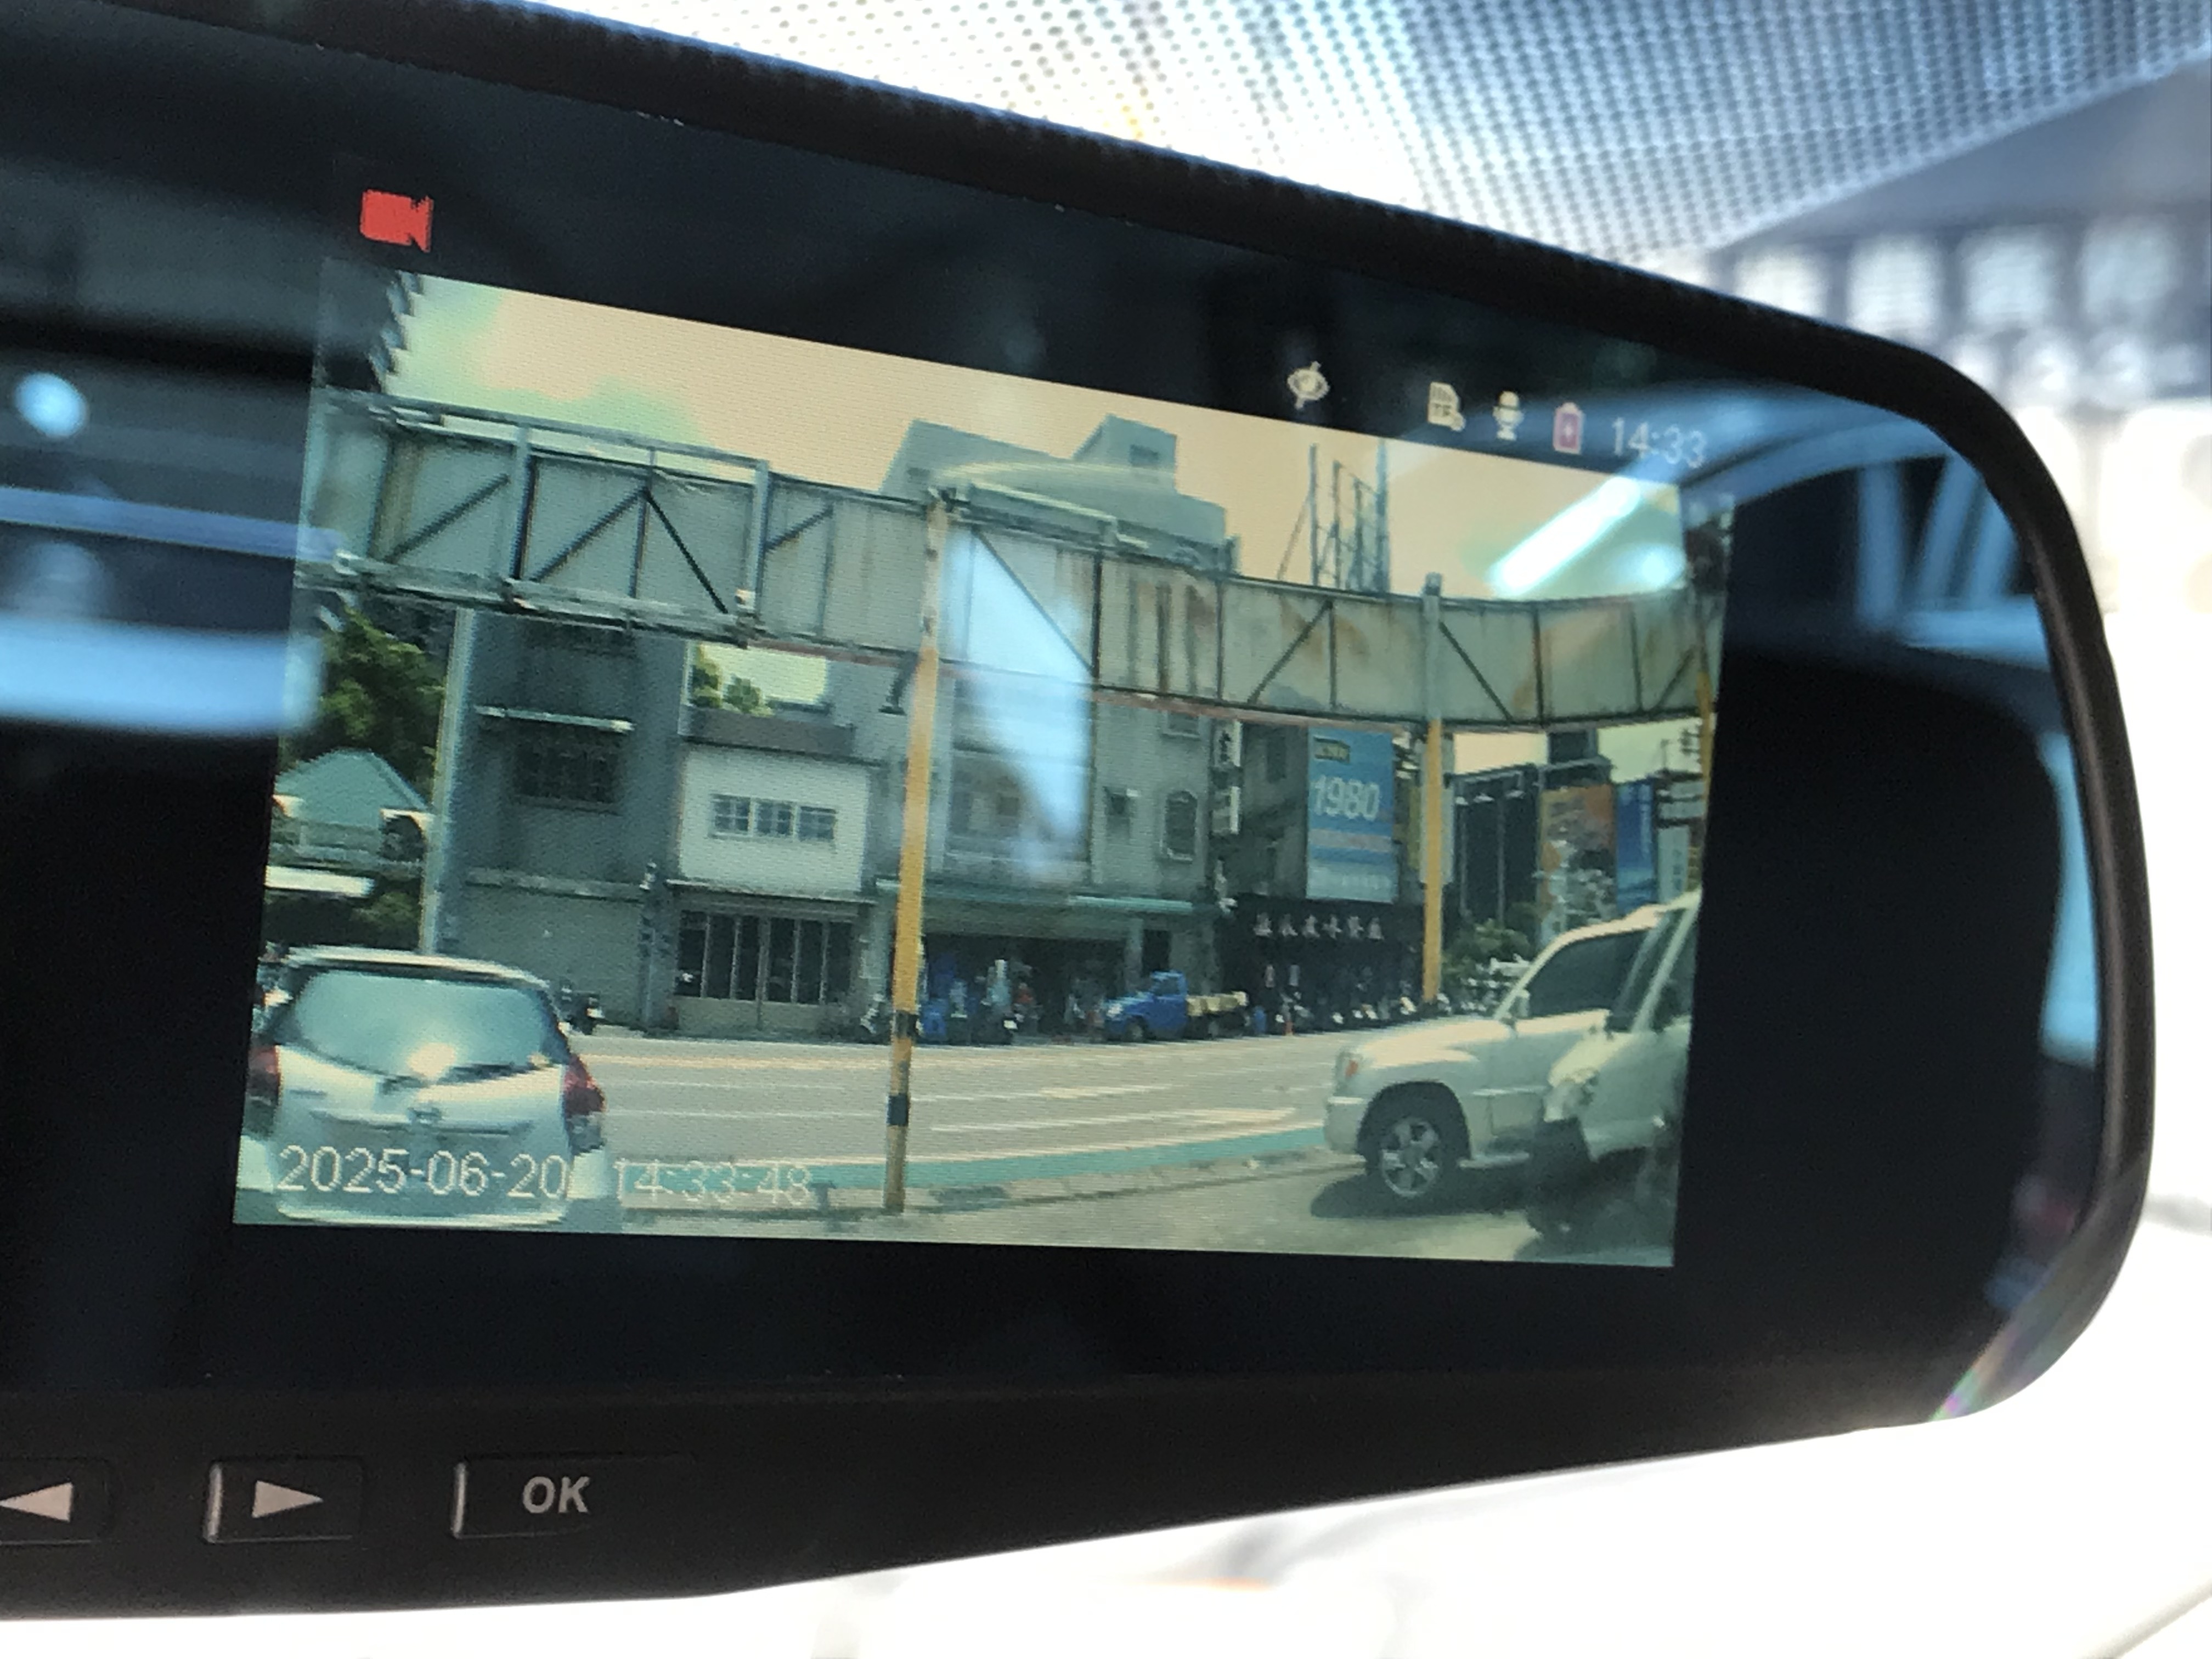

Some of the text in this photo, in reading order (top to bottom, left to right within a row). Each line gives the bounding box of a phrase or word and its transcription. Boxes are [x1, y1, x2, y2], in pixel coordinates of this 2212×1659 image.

[1612, 417, 1707, 469] 14:33
[276, 1144, 568, 1199] 2025-06-20
[613, 1158, 812, 1206] 14:33:48
[523, 1476, 591, 1514] OK
